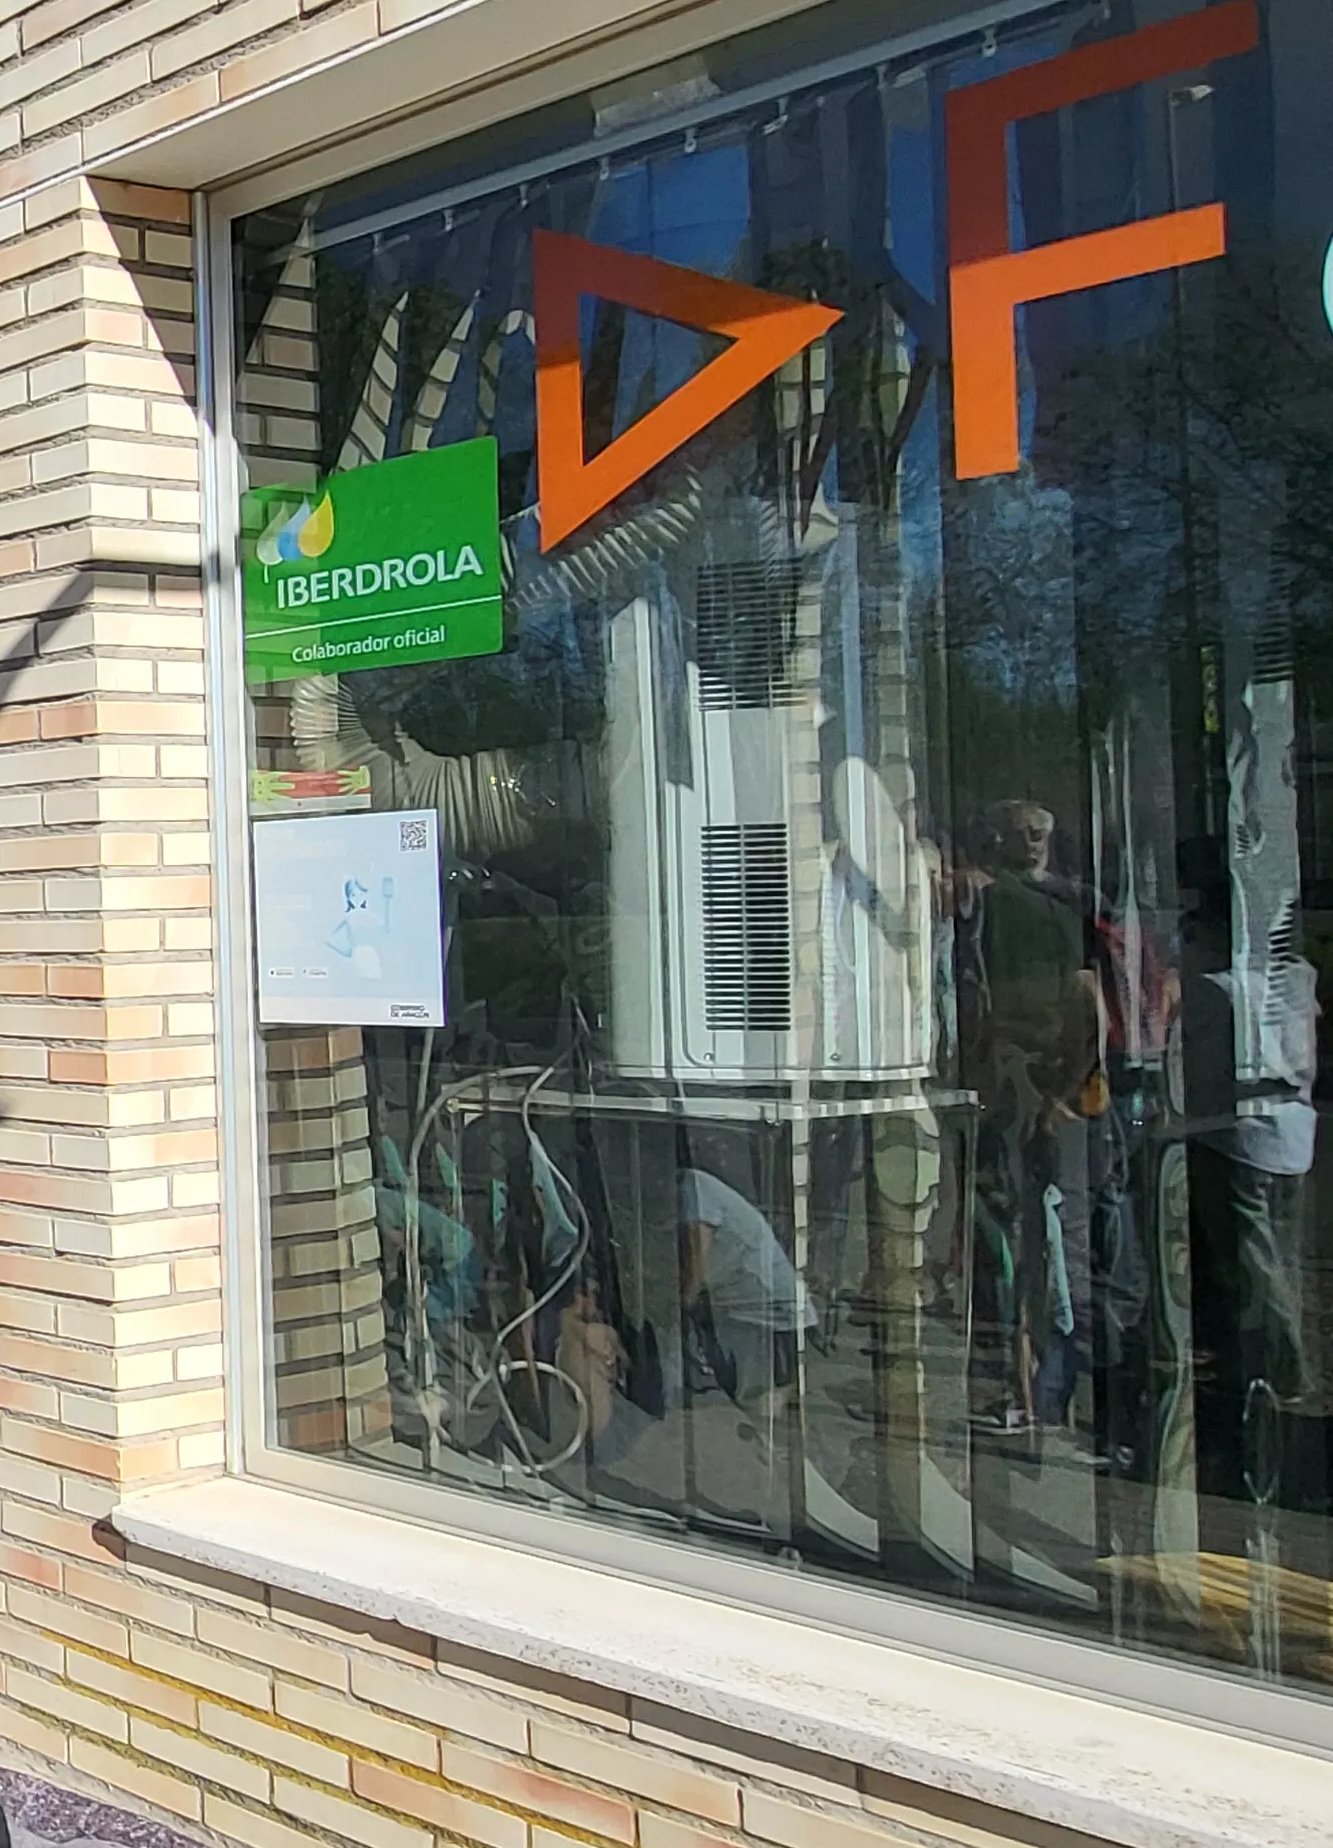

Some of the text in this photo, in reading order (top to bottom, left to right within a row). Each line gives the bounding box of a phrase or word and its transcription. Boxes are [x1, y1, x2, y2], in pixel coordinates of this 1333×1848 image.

[277, 545, 483, 609] IBERDROLA
[292, 624, 446, 663] Colaborador oficial
